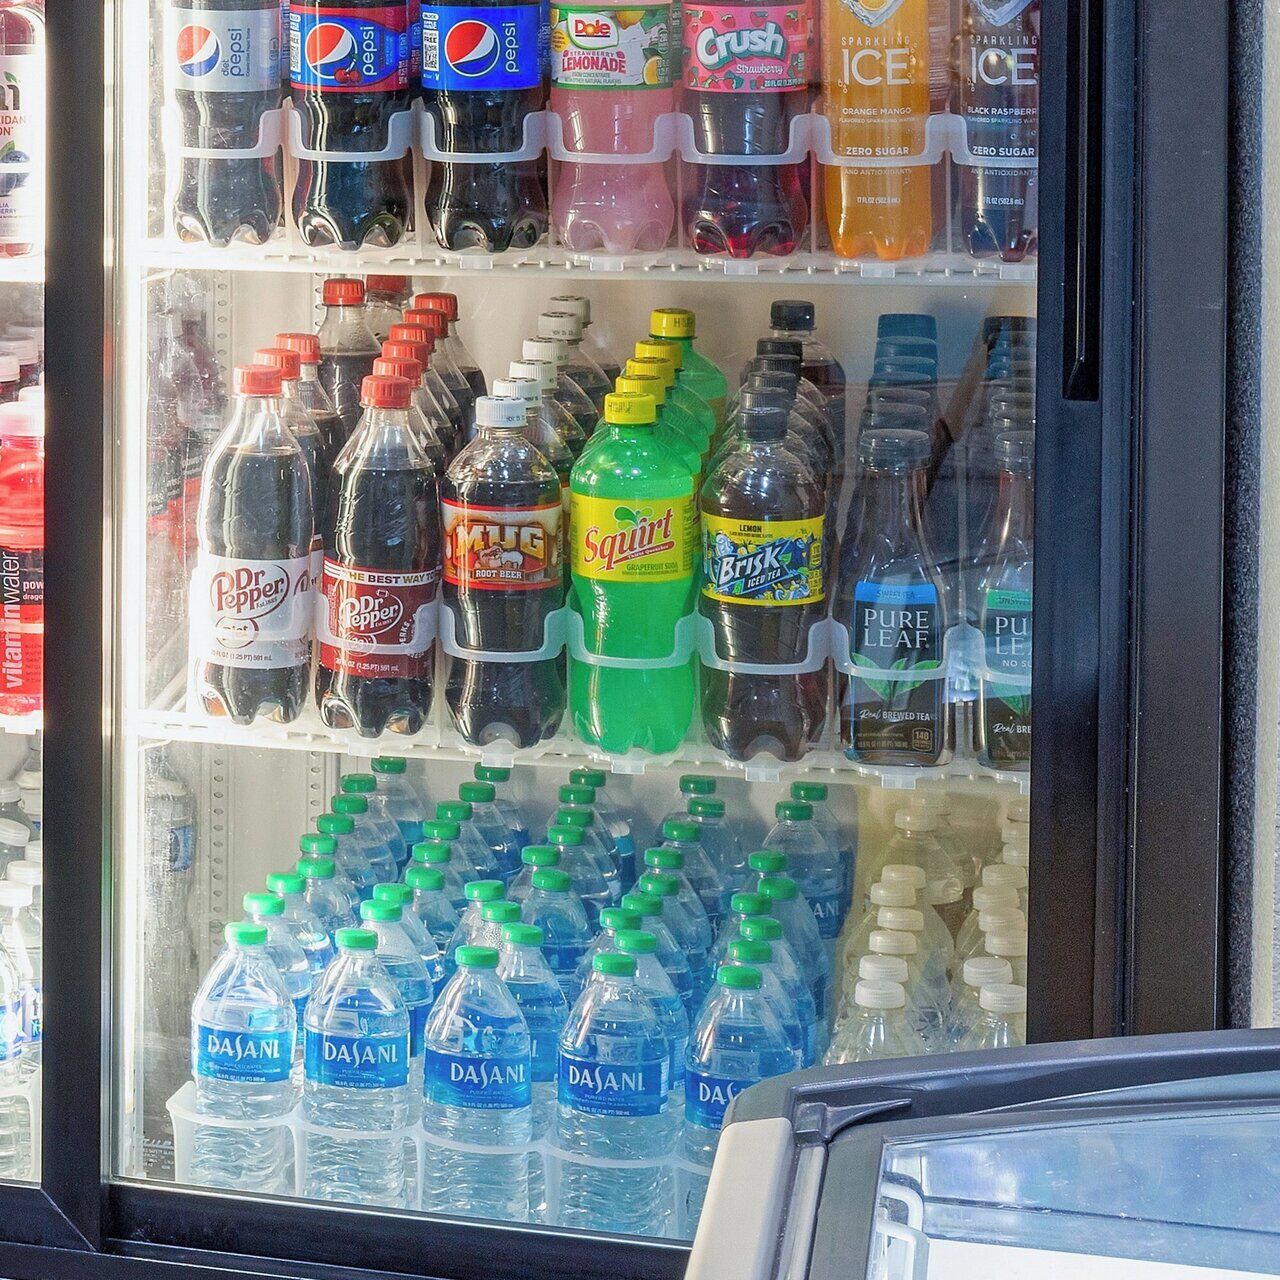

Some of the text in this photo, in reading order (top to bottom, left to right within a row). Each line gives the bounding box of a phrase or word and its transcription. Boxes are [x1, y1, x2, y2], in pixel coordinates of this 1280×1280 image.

[575, 19, 611, 37] Dole
[841, 36, 910, 46] SPARKLING
[362, 26, 376, 77] pepsi
[505, 21, 519, 73] pepsi
[696, 26, 788, 64] Crush
[562, 56, 626, 73] LEMONADE
[736, 64, 785, 76] Strawberry
[842, 47, 911, 86] ICE
[971, 47, 1038, 86] ICE
[842, 107, 912, 116] ORANGE MANGO
[846, 146, 909, 156] ZERO SUGAR
[972, 146, 1035, 156] ZERO SUGAR
[455, 523, 547, 559] MUG
[583, 507, 675, 572] Squirt
[739, 524, 763, 533] LEMON
[238, 567, 266, 592] Dr
[368, 573, 426, 584] BEST WAY
[475, 569, 523, 579] ROOT BEER
[211, 572, 285, 613] Pepper
[343, 602, 399, 629] Pepper
[359, 596, 383, 617] Dr
[864, 608, 929, 629] PURE
[0, 552, 23, 688] vitaminwater
[864, 629, 930, 649] LEAF
[207, 1033, 280, 1068] DASANI
[323, 1041, 399, 1069] DASANI
[450, 1061, 526, 1090] DASANI
[569, 1065, 647, 1096] DASANI
